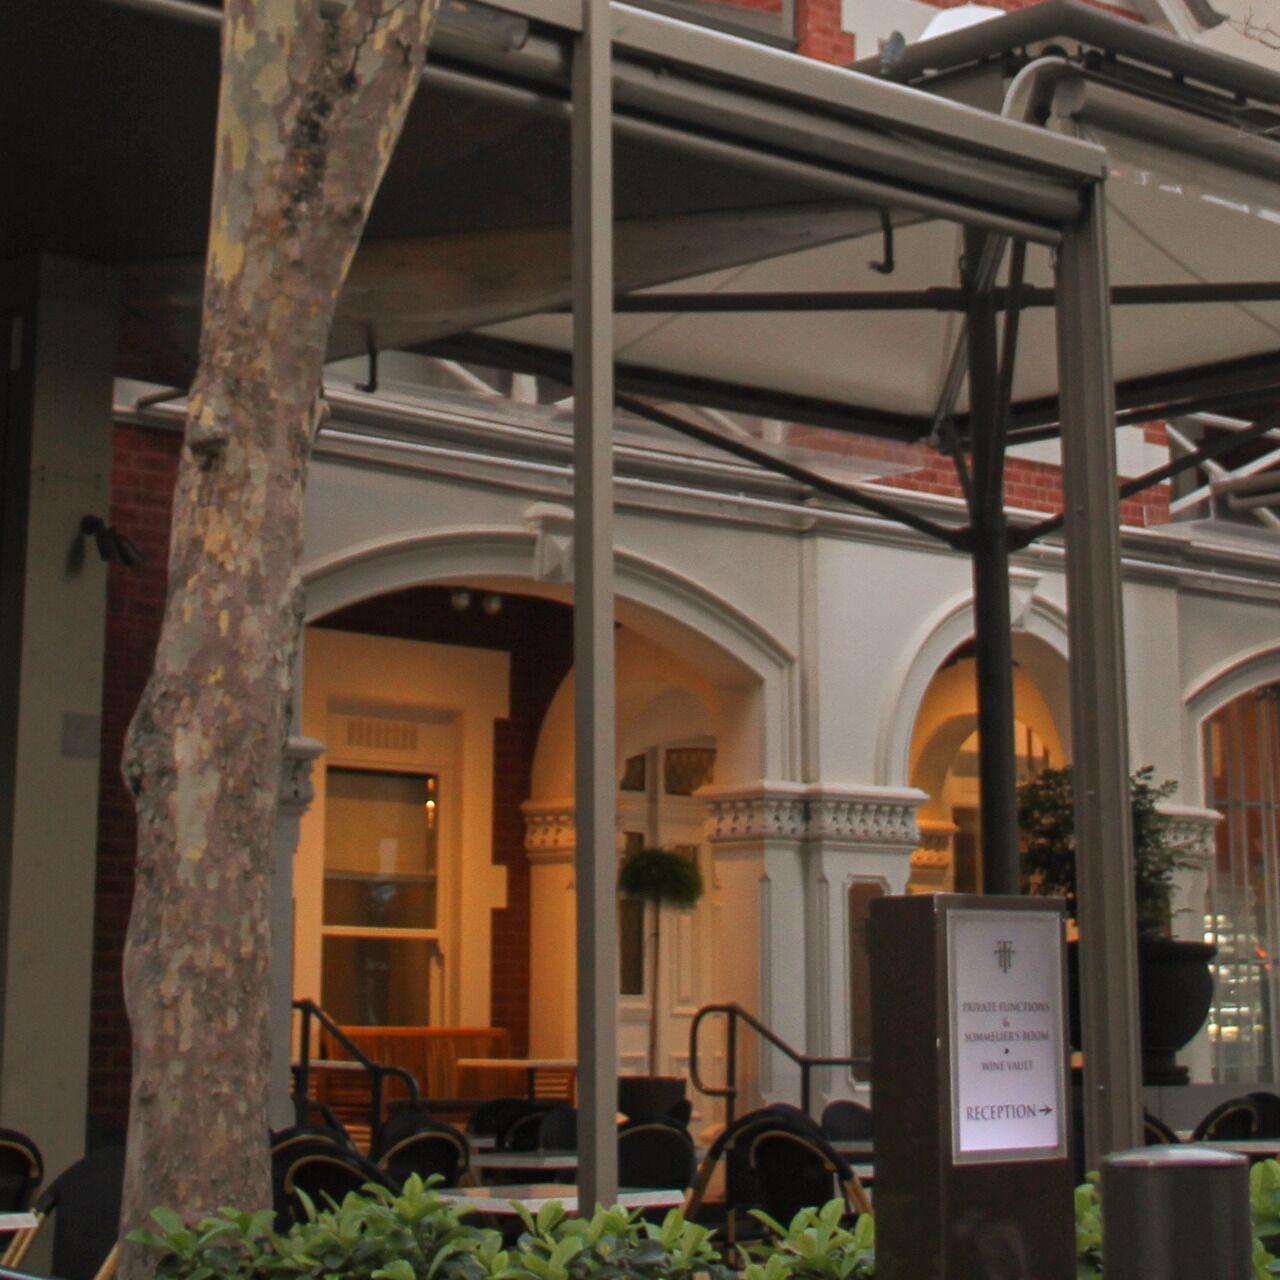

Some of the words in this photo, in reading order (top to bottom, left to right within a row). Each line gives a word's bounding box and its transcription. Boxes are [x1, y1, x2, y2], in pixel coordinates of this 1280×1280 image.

[963, 1001, 996, 1012] PRIVATE
[1000, 1001, 1050, 1012] FUNCTIONS
[1022, 1030, 1049, 1041] ROOM
[980, 1061, 1003, 1071] WINE
[1007, 1060, 1033, 1071] VAULT
[966, 1104, 1037, 1121] RECEPTION
